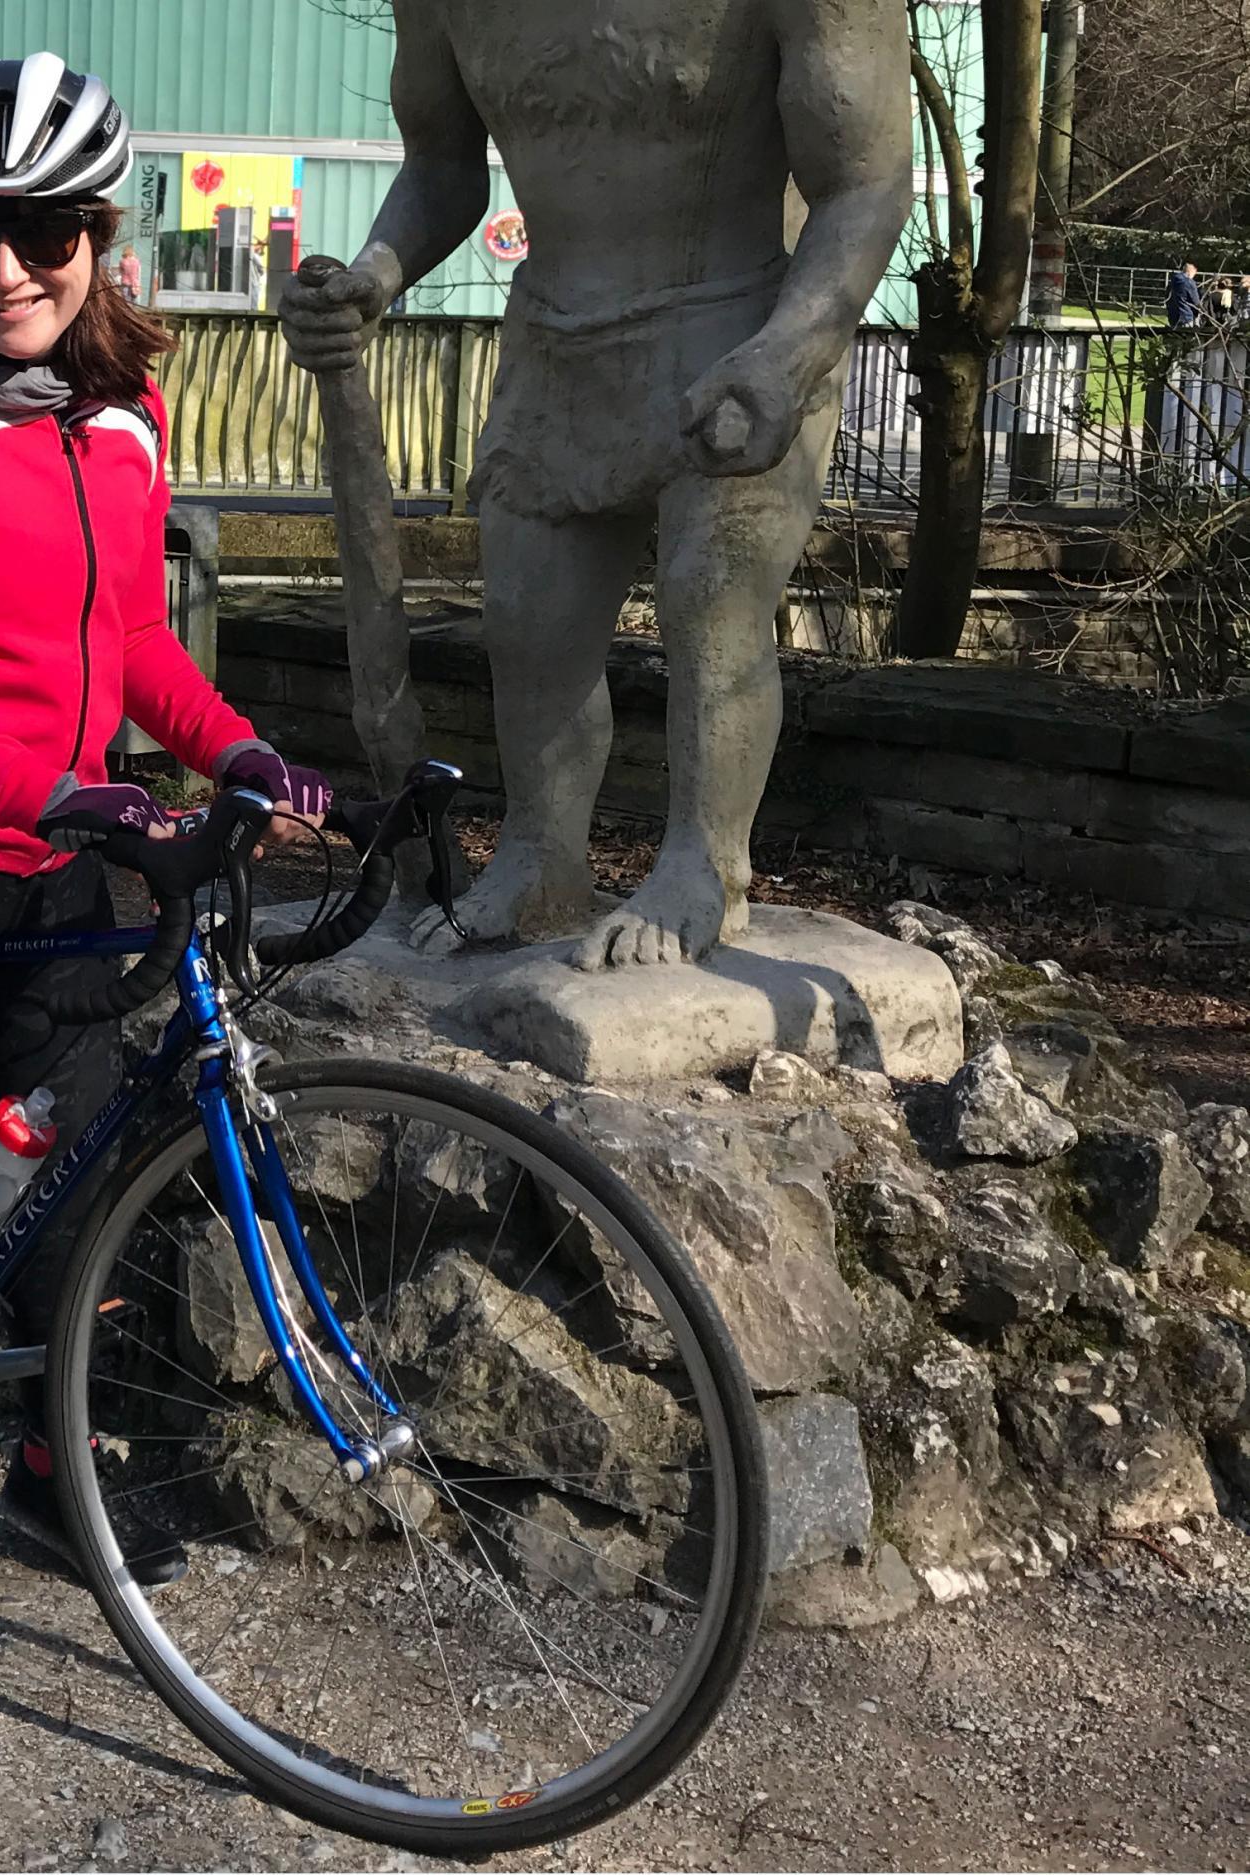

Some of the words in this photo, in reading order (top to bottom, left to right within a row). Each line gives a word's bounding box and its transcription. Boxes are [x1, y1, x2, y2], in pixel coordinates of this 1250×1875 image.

[140, 164, 155, 238] EINGANG
[4, 937, 55, 952] RICKERT
[192, 956, 212, 983] R
